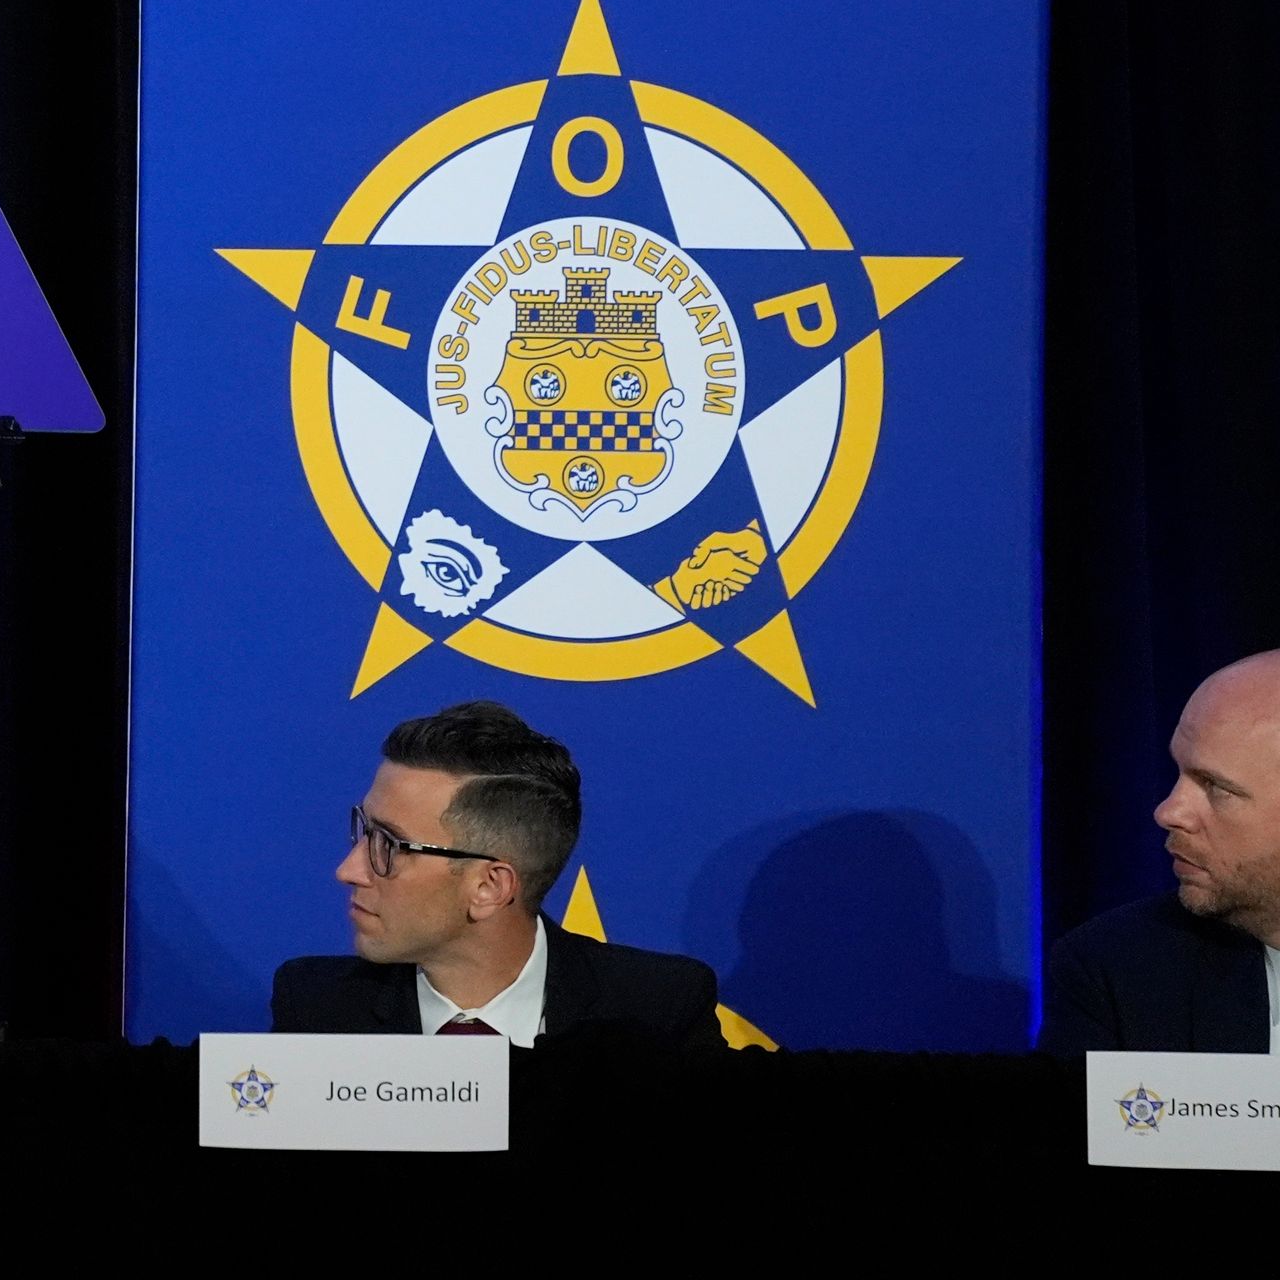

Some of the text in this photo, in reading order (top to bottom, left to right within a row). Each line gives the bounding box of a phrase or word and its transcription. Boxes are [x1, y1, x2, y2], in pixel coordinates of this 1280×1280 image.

[334, 115, 838, 351] F O P
[434, 223, 738, 418] JUS-FIDUS-LIBERTATUM
[325, 1080, 480, 1103] Joe Gamaldi
[1167, 1097, 1240, 1118] James
